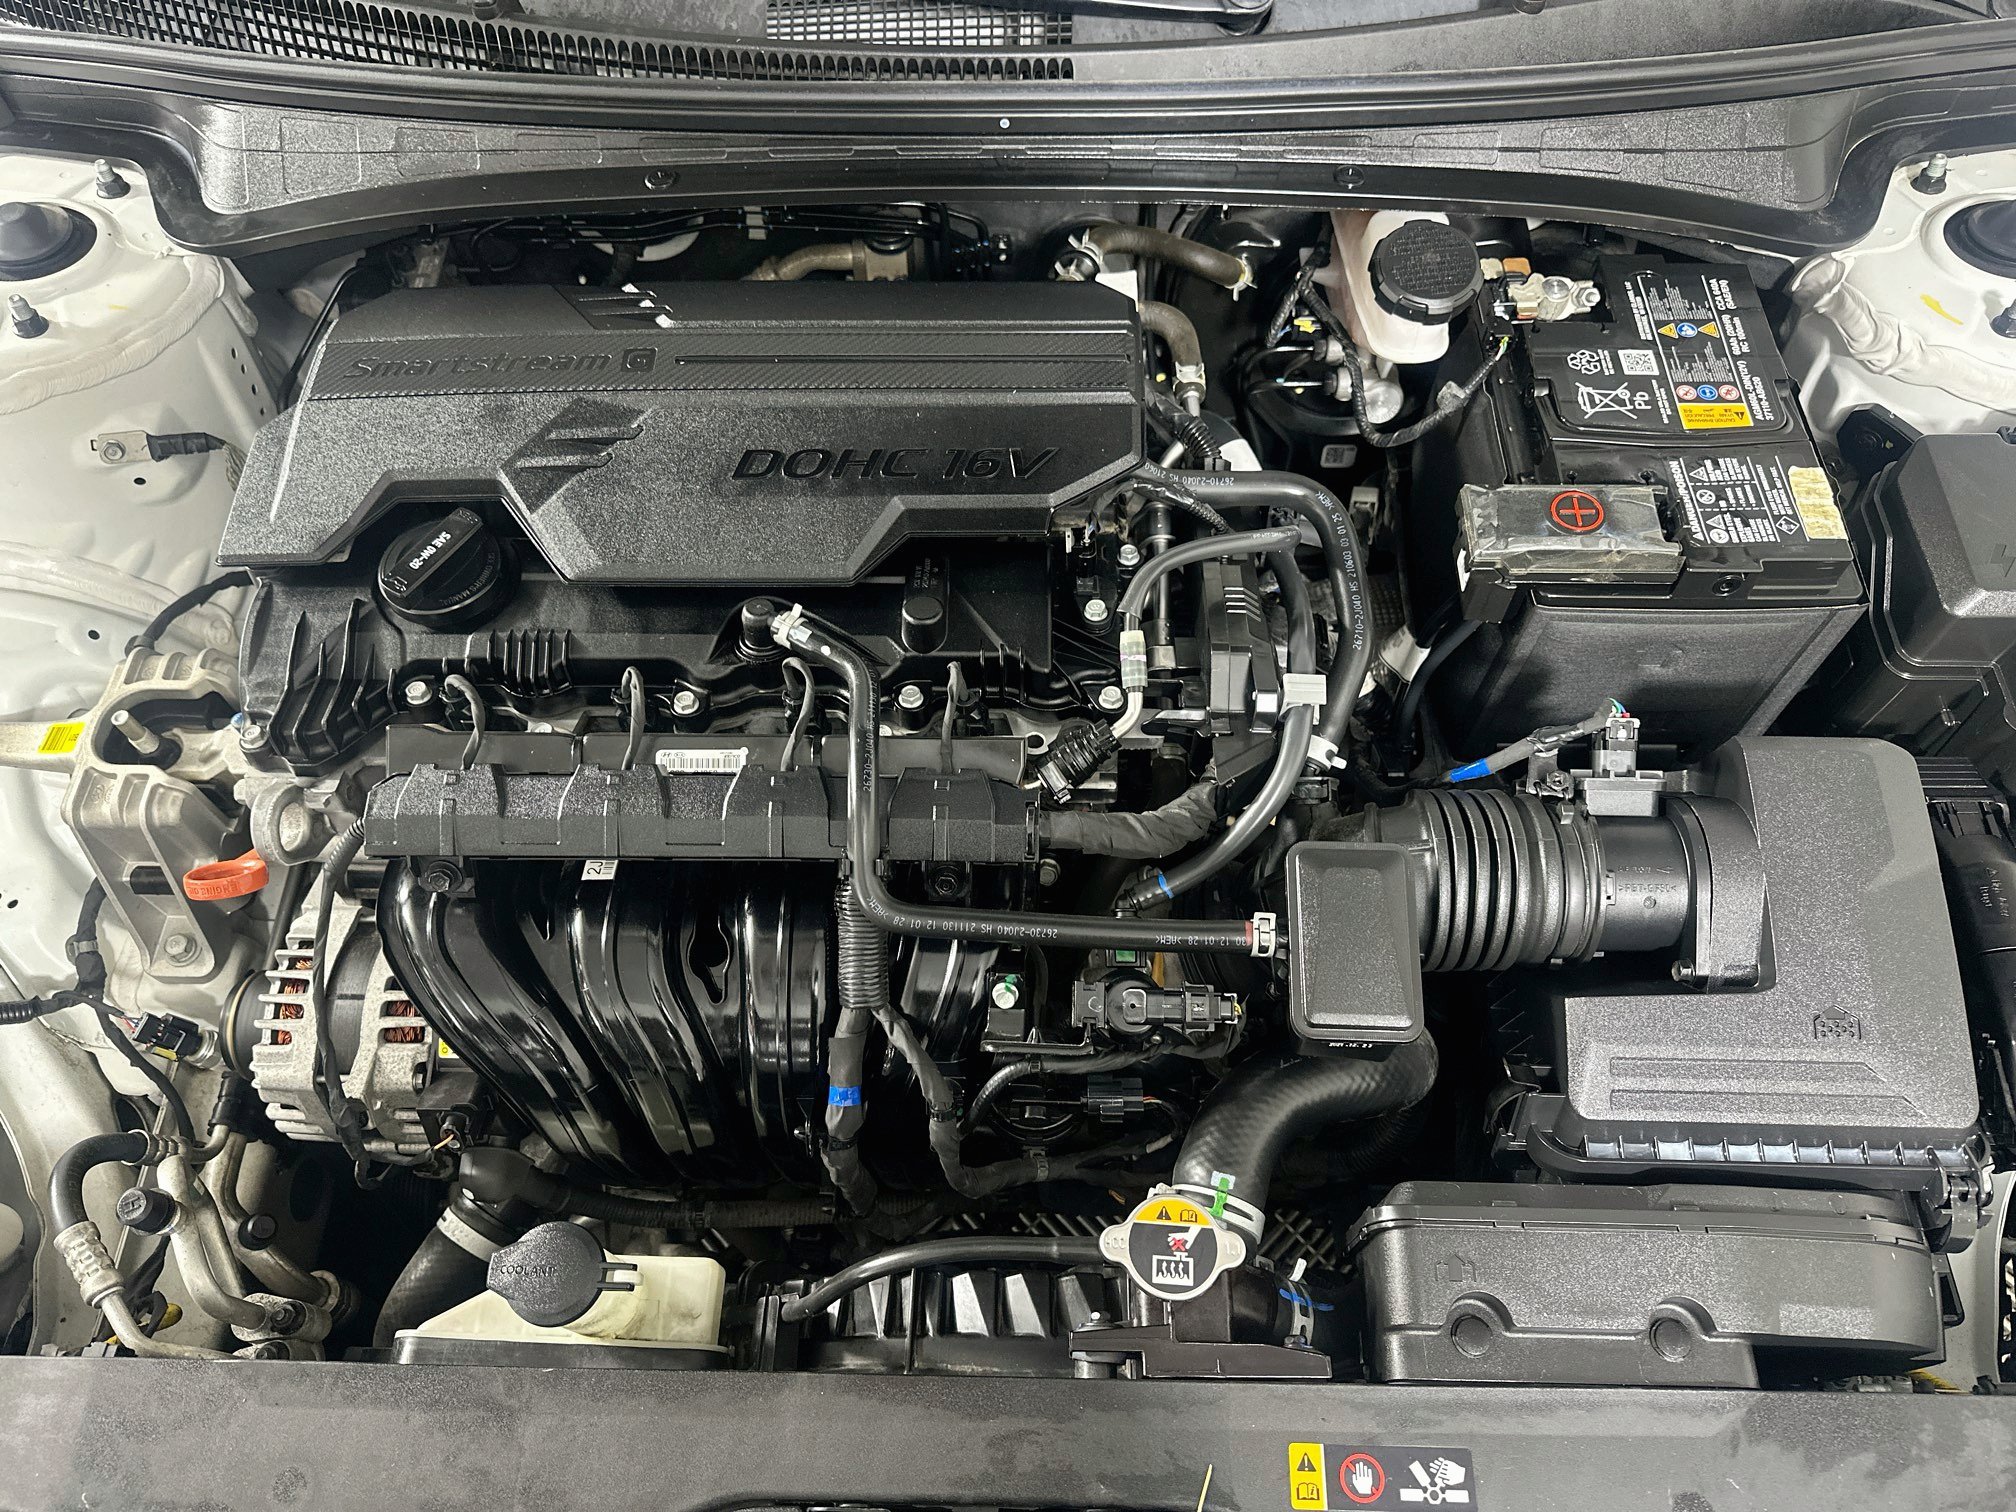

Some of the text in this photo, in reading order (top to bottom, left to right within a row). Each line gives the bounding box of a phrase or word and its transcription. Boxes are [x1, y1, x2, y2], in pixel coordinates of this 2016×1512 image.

[1709, 278, 1726, 310] CCA 640A
[1718, 280, 1737, 309] (SAE/EN)
[1721, 314, 1741, 355] 60Ah (20HR)
[1732, 317, 1750, 352] RC 100min
[343, 351, 613, 379] Smartstream
[1633, 391, 1651, 409] Pb
[731, 447, 1060, 480] DOHC 16V
[1169, 473, 1179, 483] HS
[1182, 476, 1234, 486] 26710-2J040
[1669, 460, 1701, 532] DANGER/POISON
[408, 531, 452, 570] SAE 0W-20
[1342, 551, 1356, 578] 210603
[1350, 580, 1360, 591] HS
[1352, 594, 1364, 651] 26710-2J040
[863, 732, 875, 792] 26730-2J040
[200, 880, 238, 896] ENGINE
[943, 921, 976, 933] 211130
[981, 924, 992, 934] HS
[998, 925, 1058, 938] 26730-2J040
[500, 1264, 558, 1277] COOLANT
